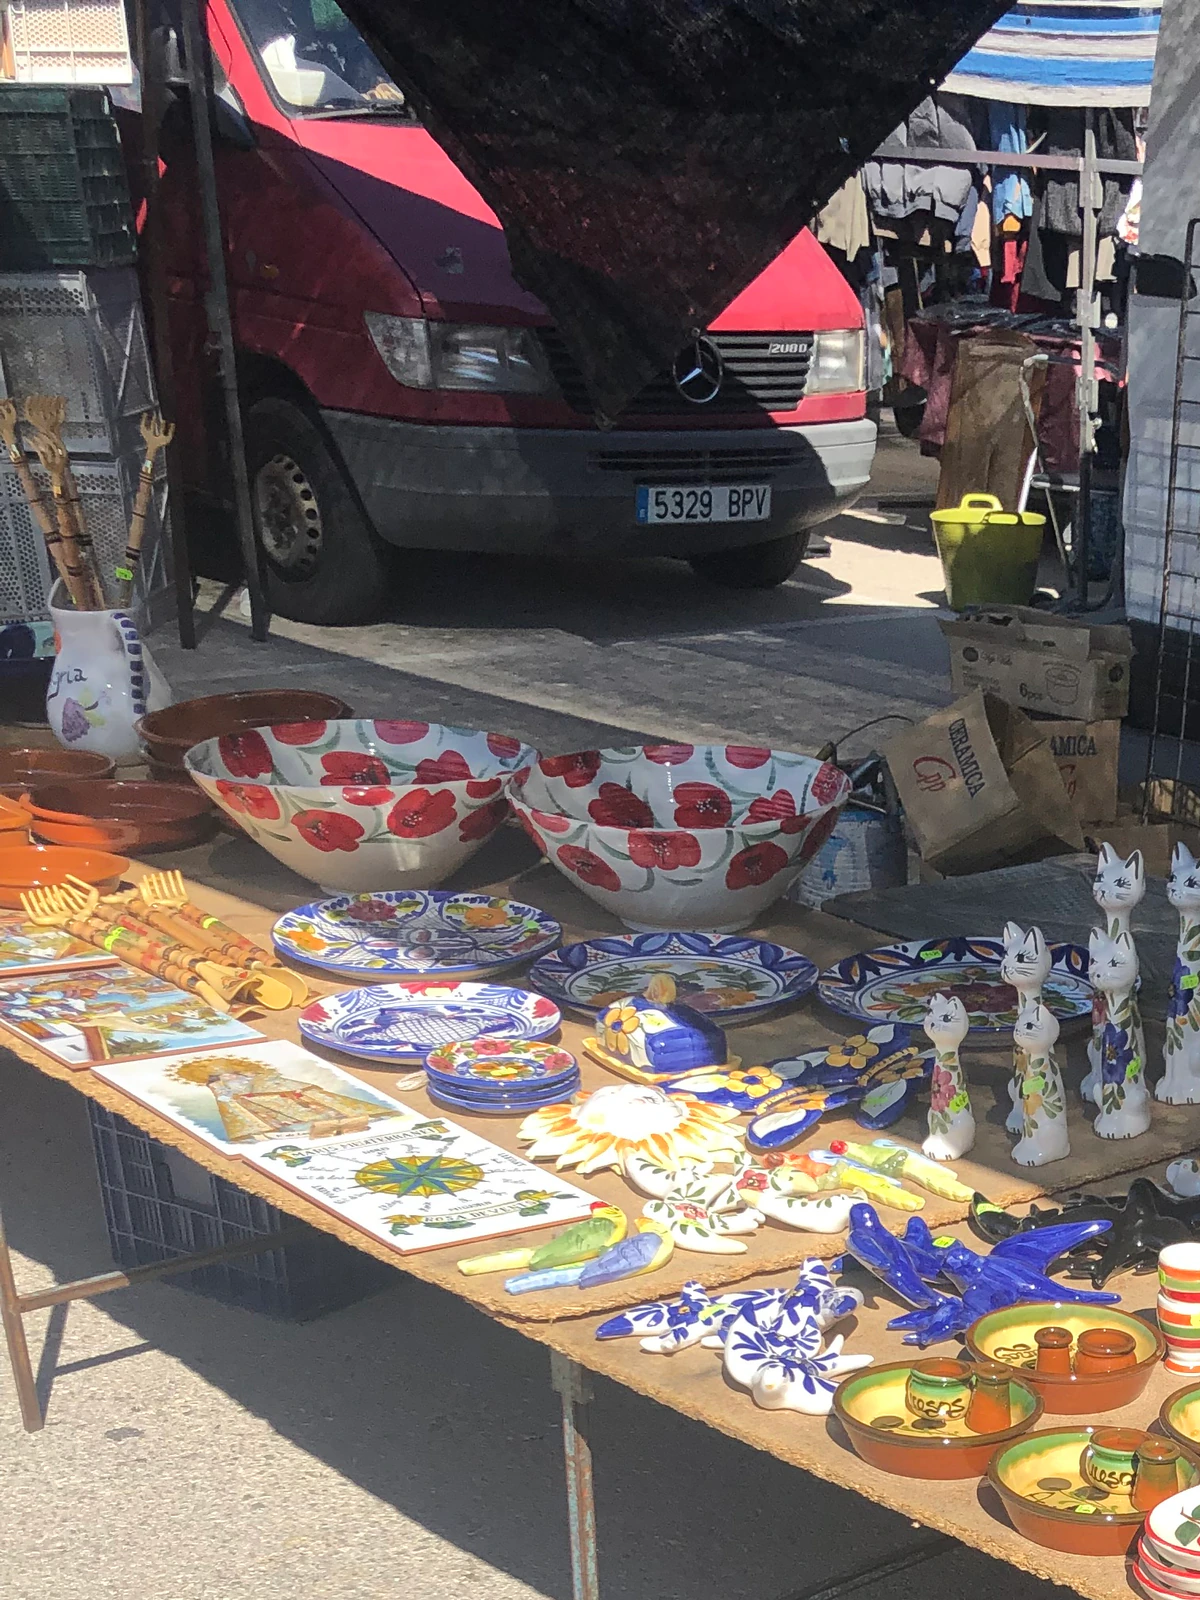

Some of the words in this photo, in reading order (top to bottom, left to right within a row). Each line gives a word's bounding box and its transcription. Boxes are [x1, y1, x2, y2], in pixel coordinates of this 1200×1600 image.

[654, 490, 713, 519] 5329
[727, 488, 767, 517] BPV
[949, 717, 986, 799] CERAMICA
[1050, 735, 1098, 756] AMICA
